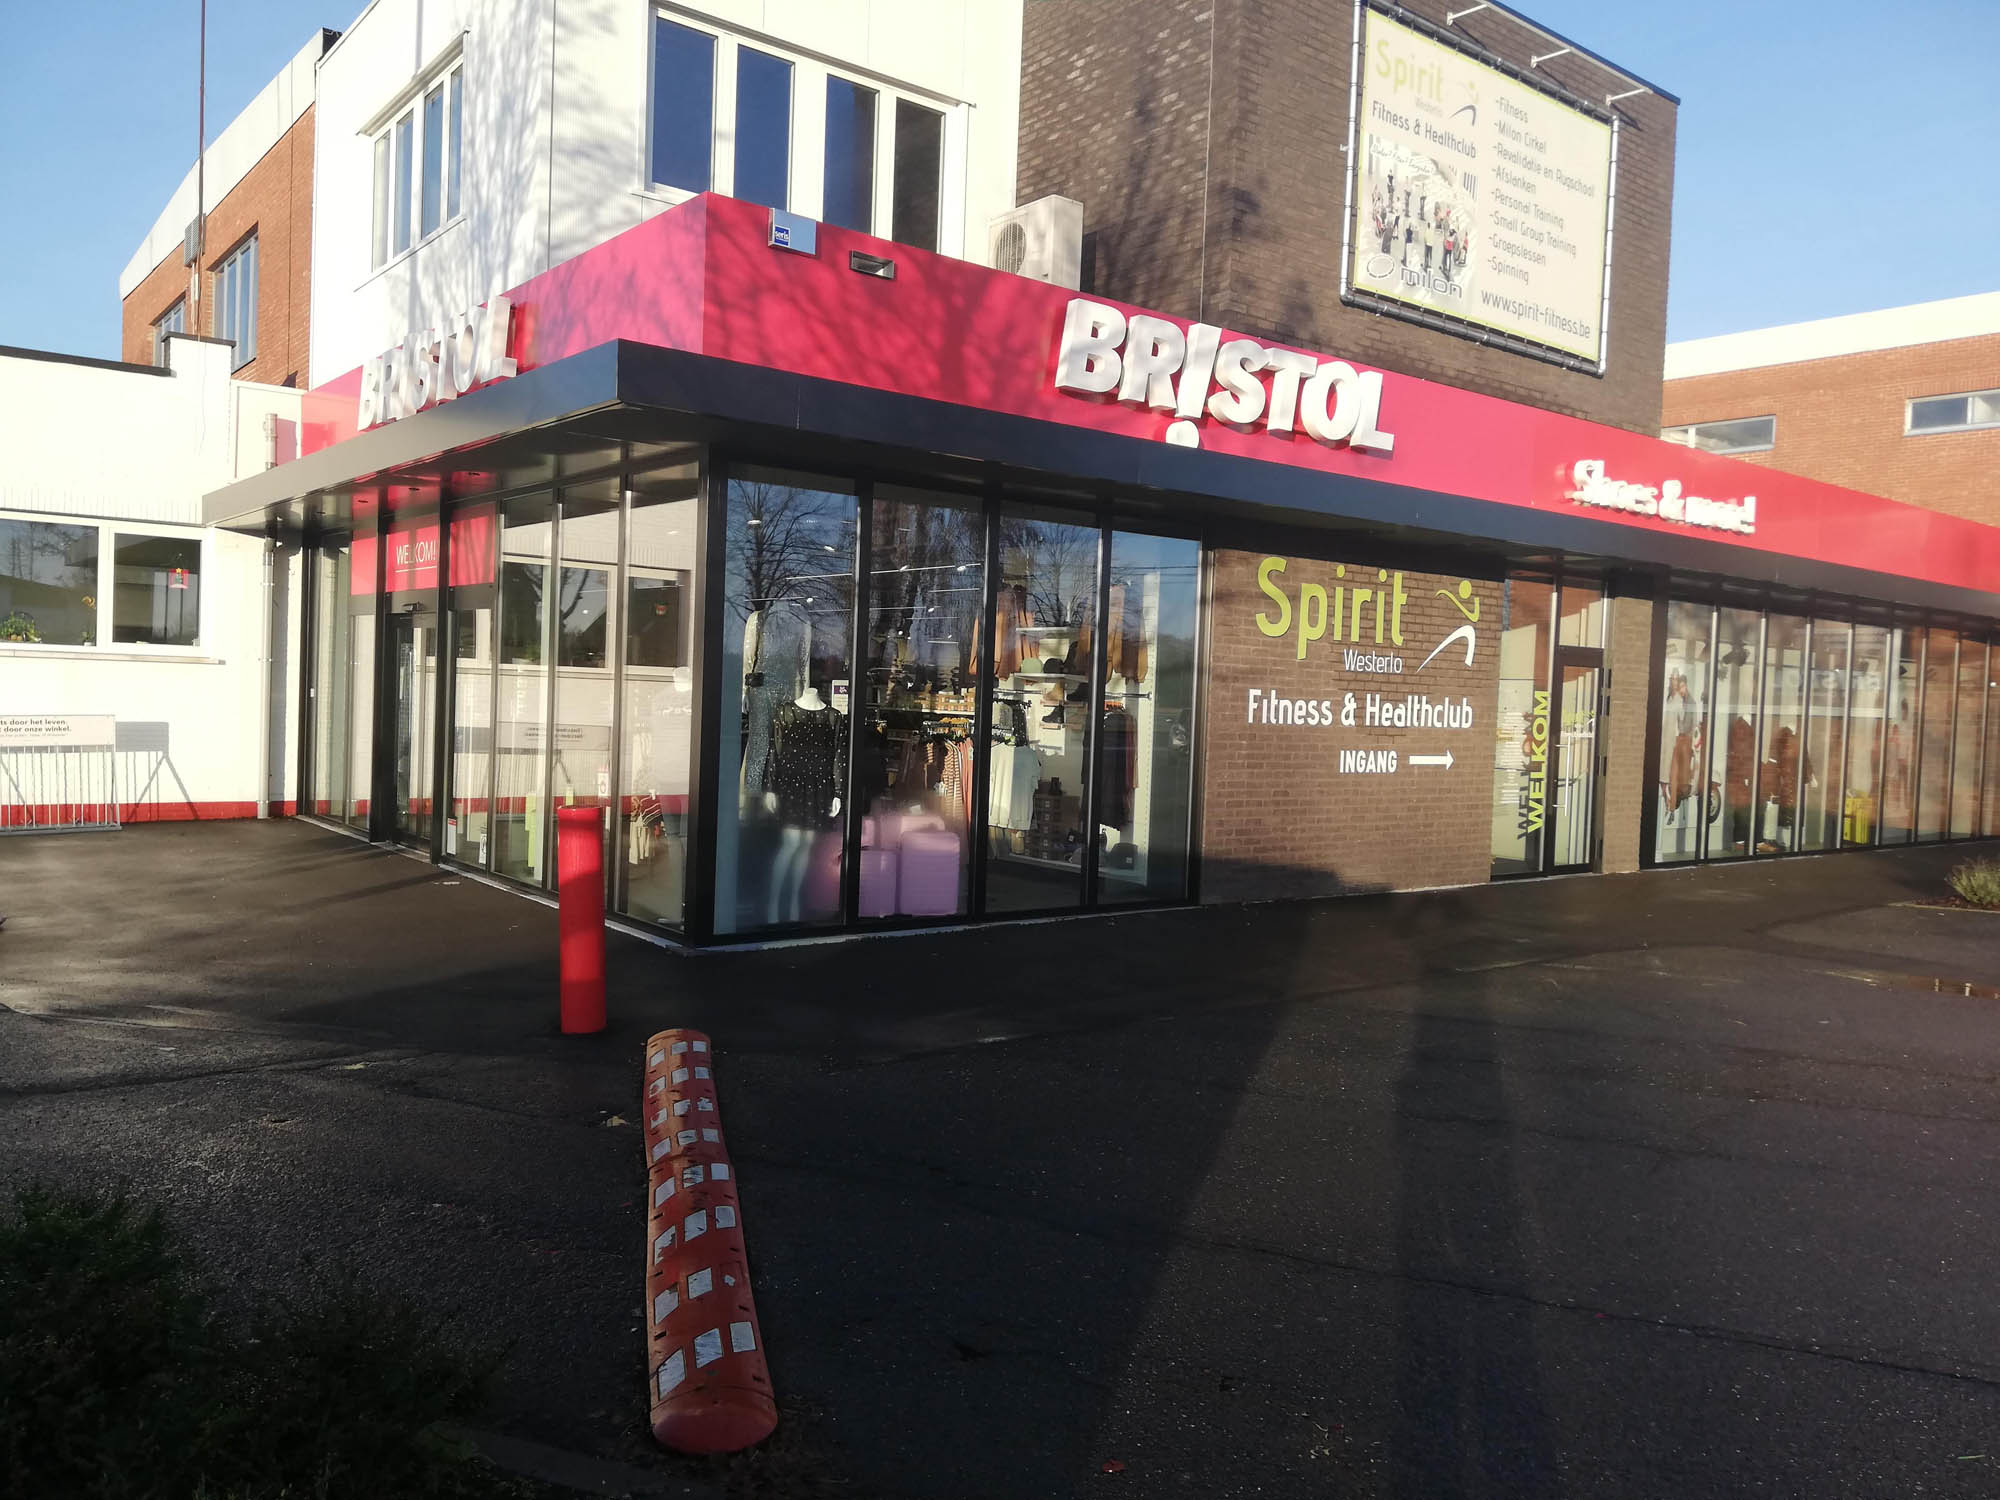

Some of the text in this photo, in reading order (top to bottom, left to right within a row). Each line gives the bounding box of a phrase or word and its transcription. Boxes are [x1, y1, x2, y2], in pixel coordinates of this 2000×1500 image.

[1376, 38, 1444, 104] Spirit
[1372, 100, 1410, 132] Fitness
[1413, 119, 1421, 136] &
[1425, 122, 1477, 159] Healthclub
[1533, 203, 1565, 232] Training
[1520, 221, 1545, 246] Group
[1546, 231, 1577, 259] Training
[1401, 266, 1463, 299] milon
[1481, 289, 1592, 339] www.spirit-fitness.be
[1255, 556, 1409, 661] Spirit
[1343, 648, 1403, 674] Westerlo
[1247, 688, 1474, 730] Fitness & Healthclub
[1339, 749, 1398, 774] INGANG
[1527, 690, 1550, 834] WELKOM
